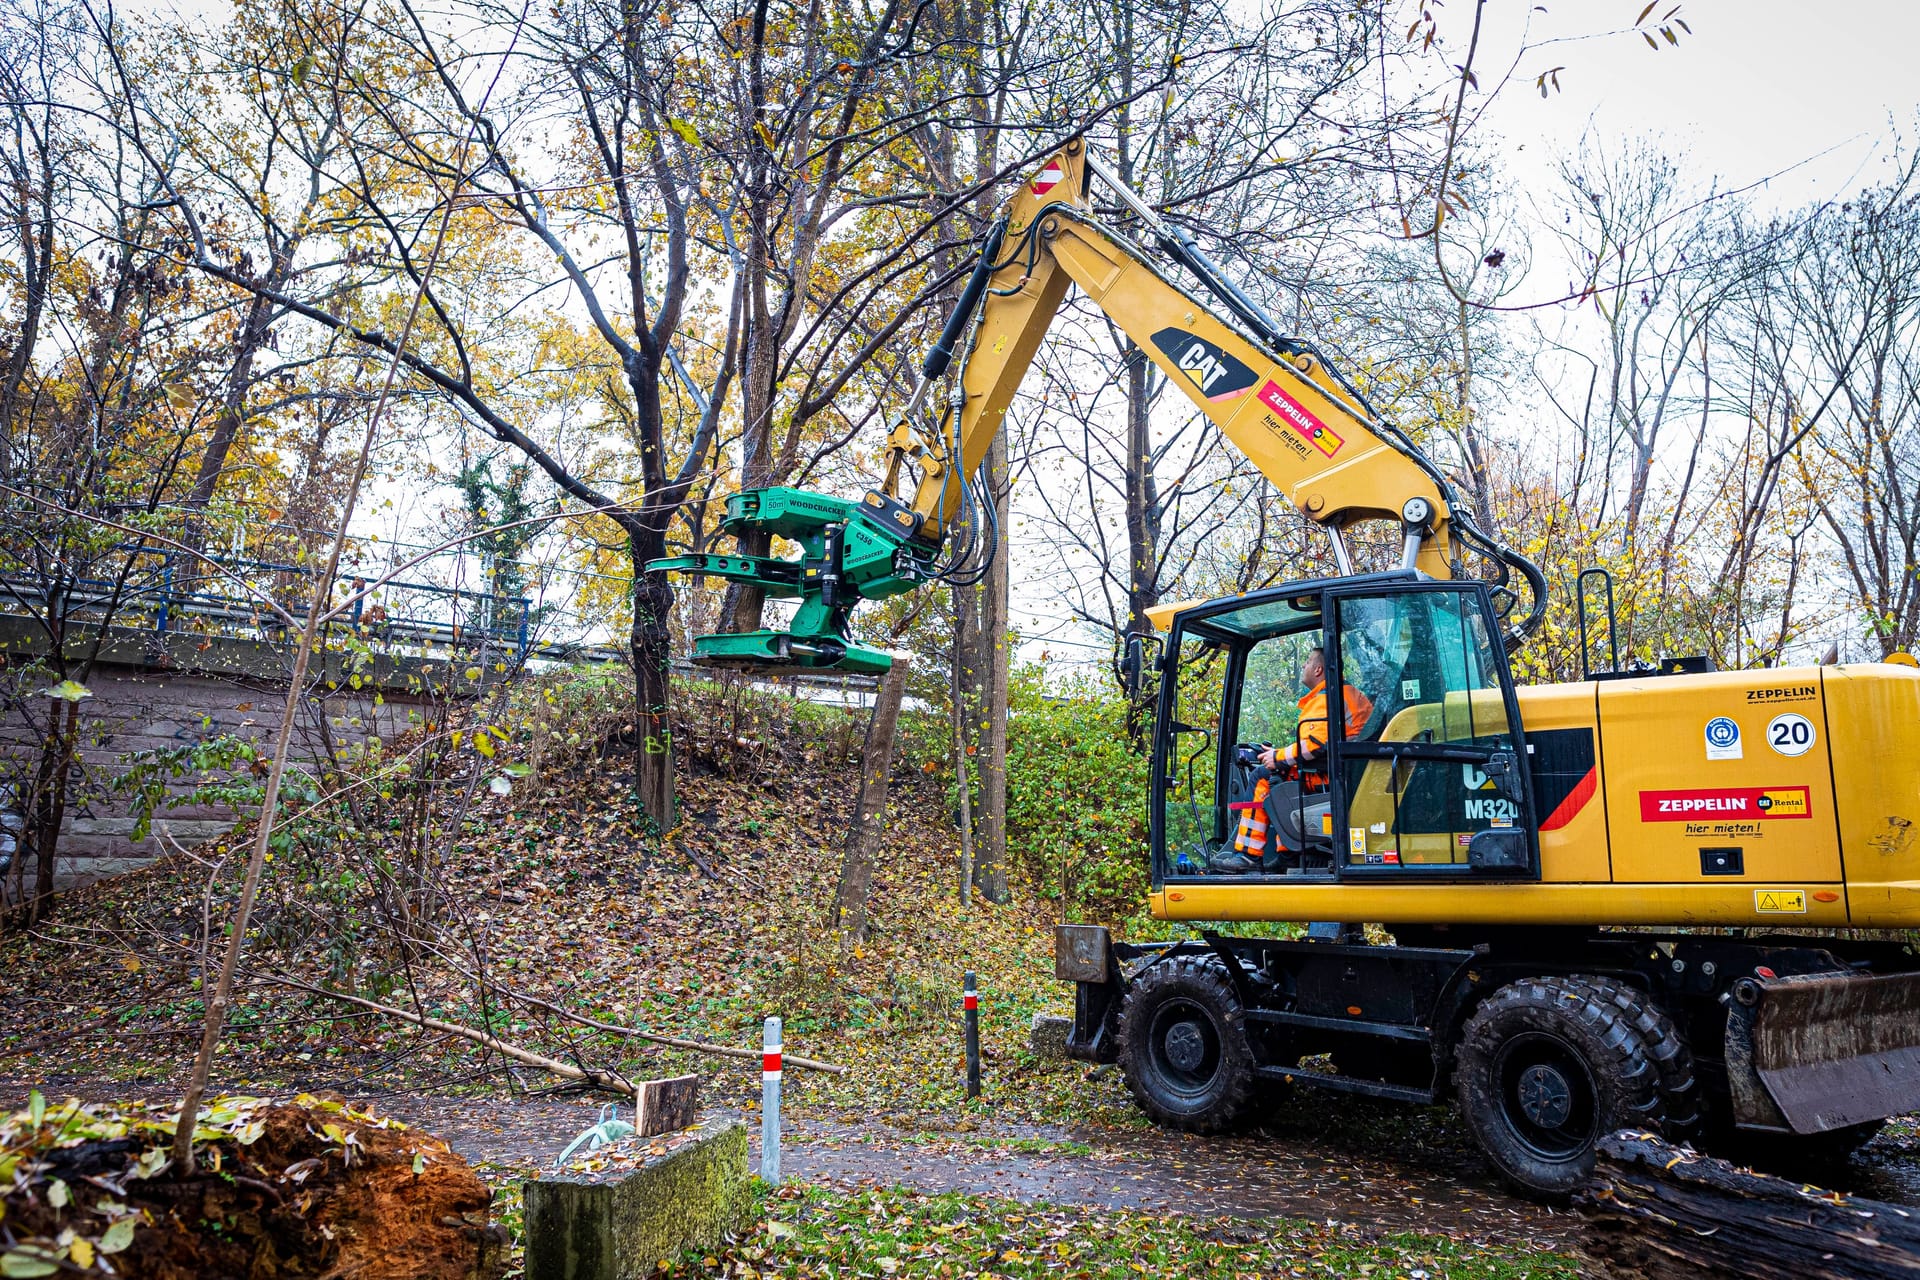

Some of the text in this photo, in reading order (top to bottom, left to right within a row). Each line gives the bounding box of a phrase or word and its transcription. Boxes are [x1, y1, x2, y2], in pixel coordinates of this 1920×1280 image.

[1179, 343, 1228, 392] CAT
[1268, 391, 1313, 430] ZEPPELIN
[1263, 414, 1281, 430] hier
[768, 501, 784, 509] 50m
[789, 499, 847, 516] WOODCRACKER
[856, 532, 873, 546] C350
[1746, 686, 1816, 700] ZEPPELIN
[1773, 722, 1810, 746] 20
[1658, 797, 1745, 812] ZEPPELIN
[1686, 823, 1709, 833] hier
